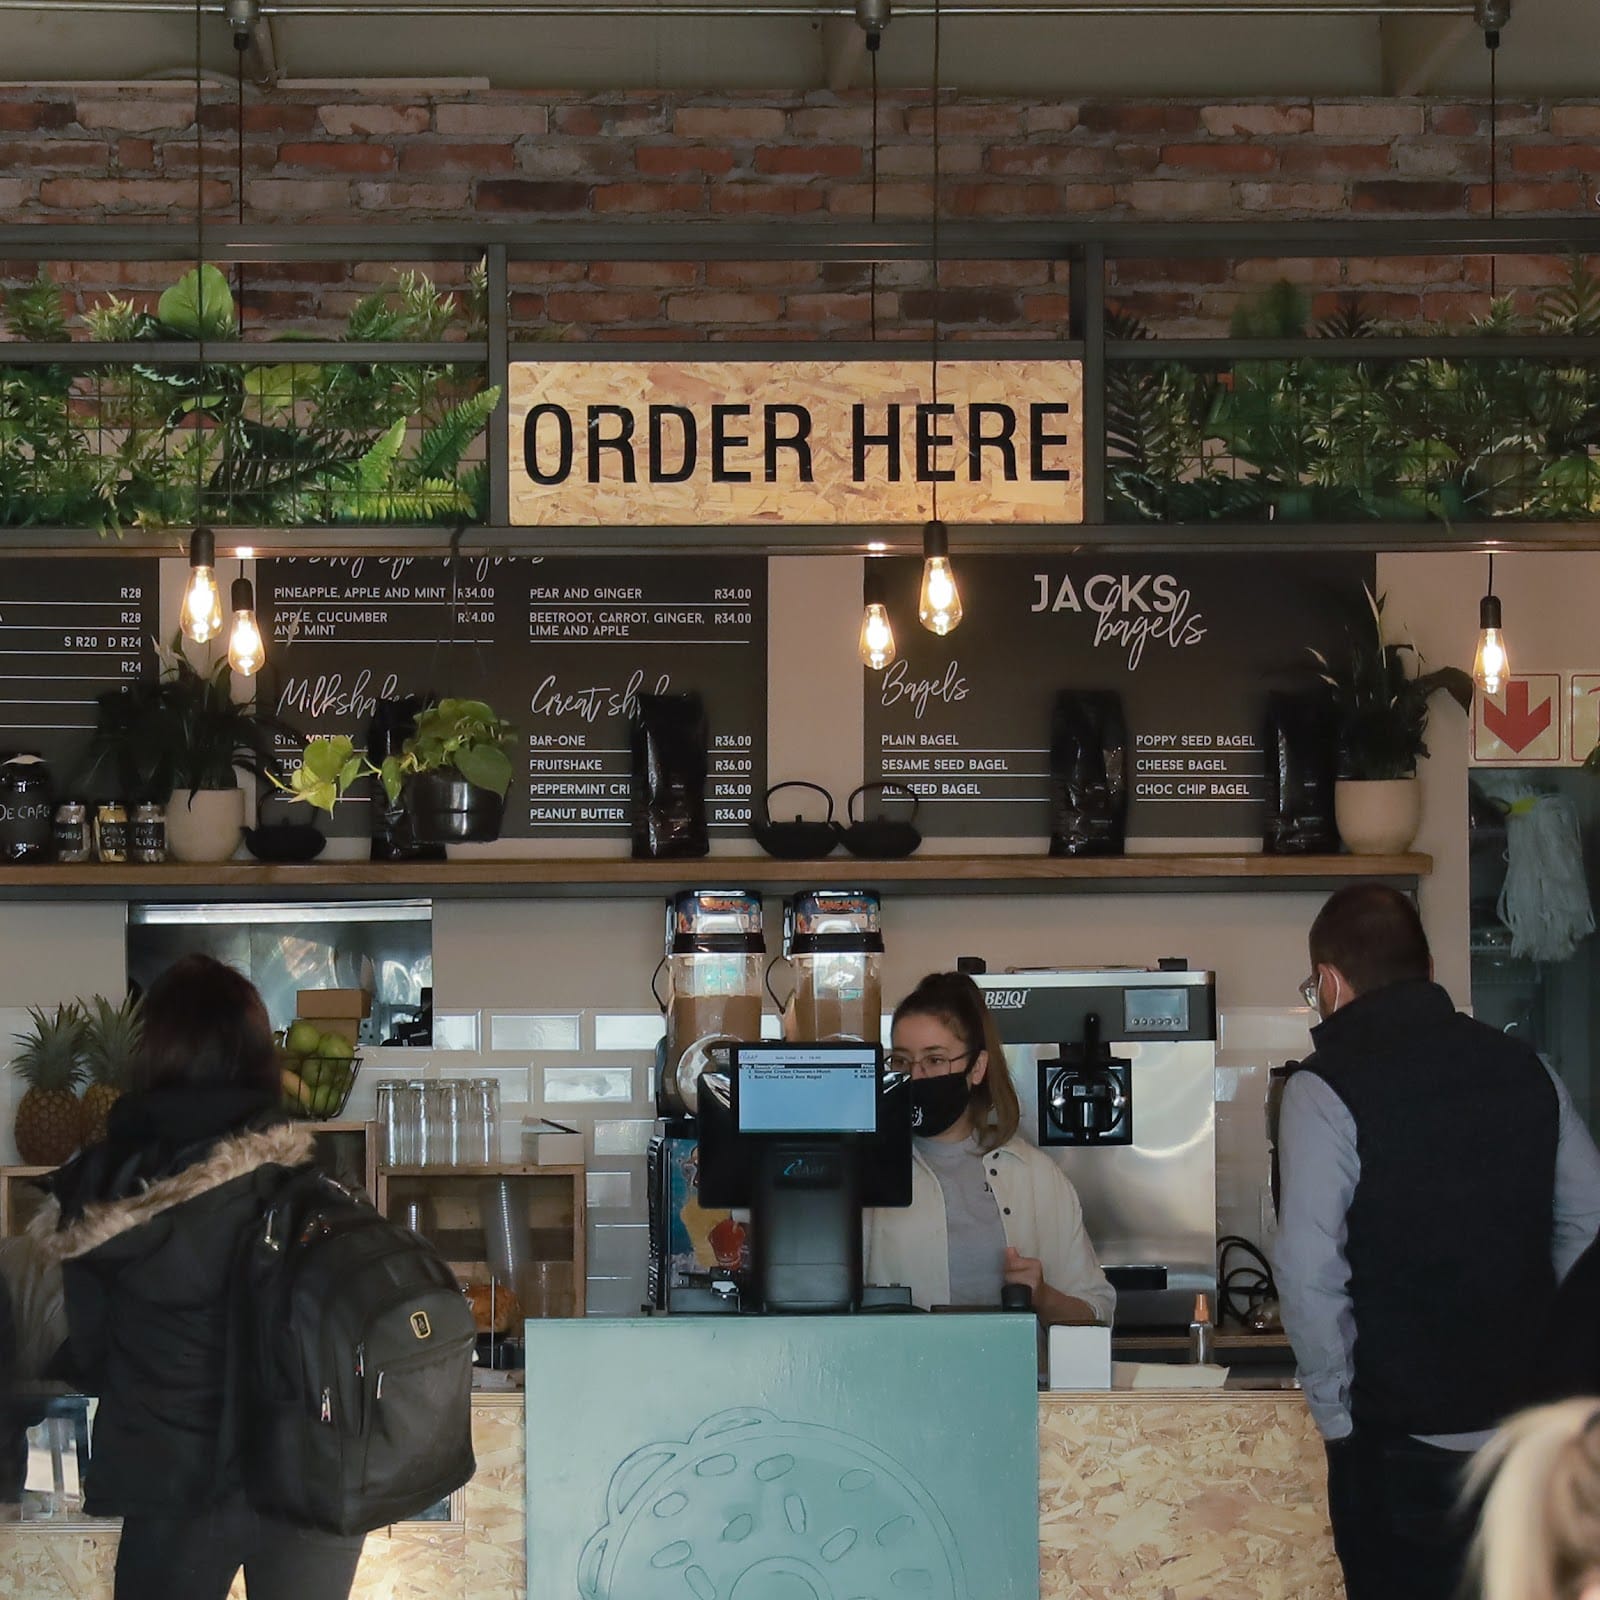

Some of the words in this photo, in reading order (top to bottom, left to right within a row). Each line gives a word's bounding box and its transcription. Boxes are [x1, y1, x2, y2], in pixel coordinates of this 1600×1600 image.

[524, 403, 814, 484] ORDER
[852, 403, 1070, 482] HERE
[121, 588, 141, 598] R28
[275, 587, 340, 597] PINEAPPLE,
[344, 588, 380, 598] APPLE
[385, 588, 410, 597] AND
[415, 588, 445, 598] MINT
[531, 588, 559, 598] PEAR
[564, 588, 589, 598] AND
[594, 588, 642, 598] GINGER
[715, 589, 751, 599] R34.00
[1032, 574, 1178, 613] JACKS
[121, 613, 141, 623] R28
[274, 612, 312, 624] APPLE,
[317, 612, 387, 622] CUCUMBER
[530, 612, 594, 624] BEETROOT,
[599, 613, 649, 623] CARROT,
[654, 613, 704, 623] GINGER,
[715, 613, 751, 624] R34.00
[274, 625, 299, 636] AND
[305, 625, 335, 635] MINT
[530, 625, 559, 635] LIME
[563, 626, 588, 635] AND
[593, 626, 629, 635] APPLE
[1094, 589, 1207, 670] bagels
[65, 636, 71, 646] S
[76, 637, 97, 647] R20
[108, 637, 116, 647] D
[121, 637, 141, 647] R24
[122, 662, 141, 672] R24
[882, 659, 969, 719] Bagels
[531, 675, 610, 722] Great
[530, 736, 585, 745] BAR-ONE
[716, 736, 751, 746] R36.00
[882, 735, 915, 745] PLAIN
[921, 735, 959, 745] BAGEL
[1137, 735, 1177, 745] POPPY
[1182, 736, 1211, 745] SEED
[1217, 736, 1255, 746] BAGEL
[530, 760, 602, 770] FRUITSHAKE
[716, 760, 751, 770] R36.00
[882, 760, 929, 769] SESAME
[935, 760, 964, 769] SEED
[970, 760, 1008, 769] BAGEL
[1137, 760, 1183, 770] CHEESE
[1189, 760, 1227, 770] BAGEL
[531, 784, 605, 794] PEPPERMINT
[716, 785, 751, 795] R36.00
[942, 784, 980, 794] BAGEL
[1136, 784, 1172, 794] CHOC
[1178, 784, 1206, 794] CHIP
[1211, 784, 1249, 794] BAGEL
[531, 808, 576, 819] PEANUT
[581, 809, 624, 819] BUTTER
[716, 809, 751, 819] R36.00
[985, 990, 1028, 1008] BEIQI
